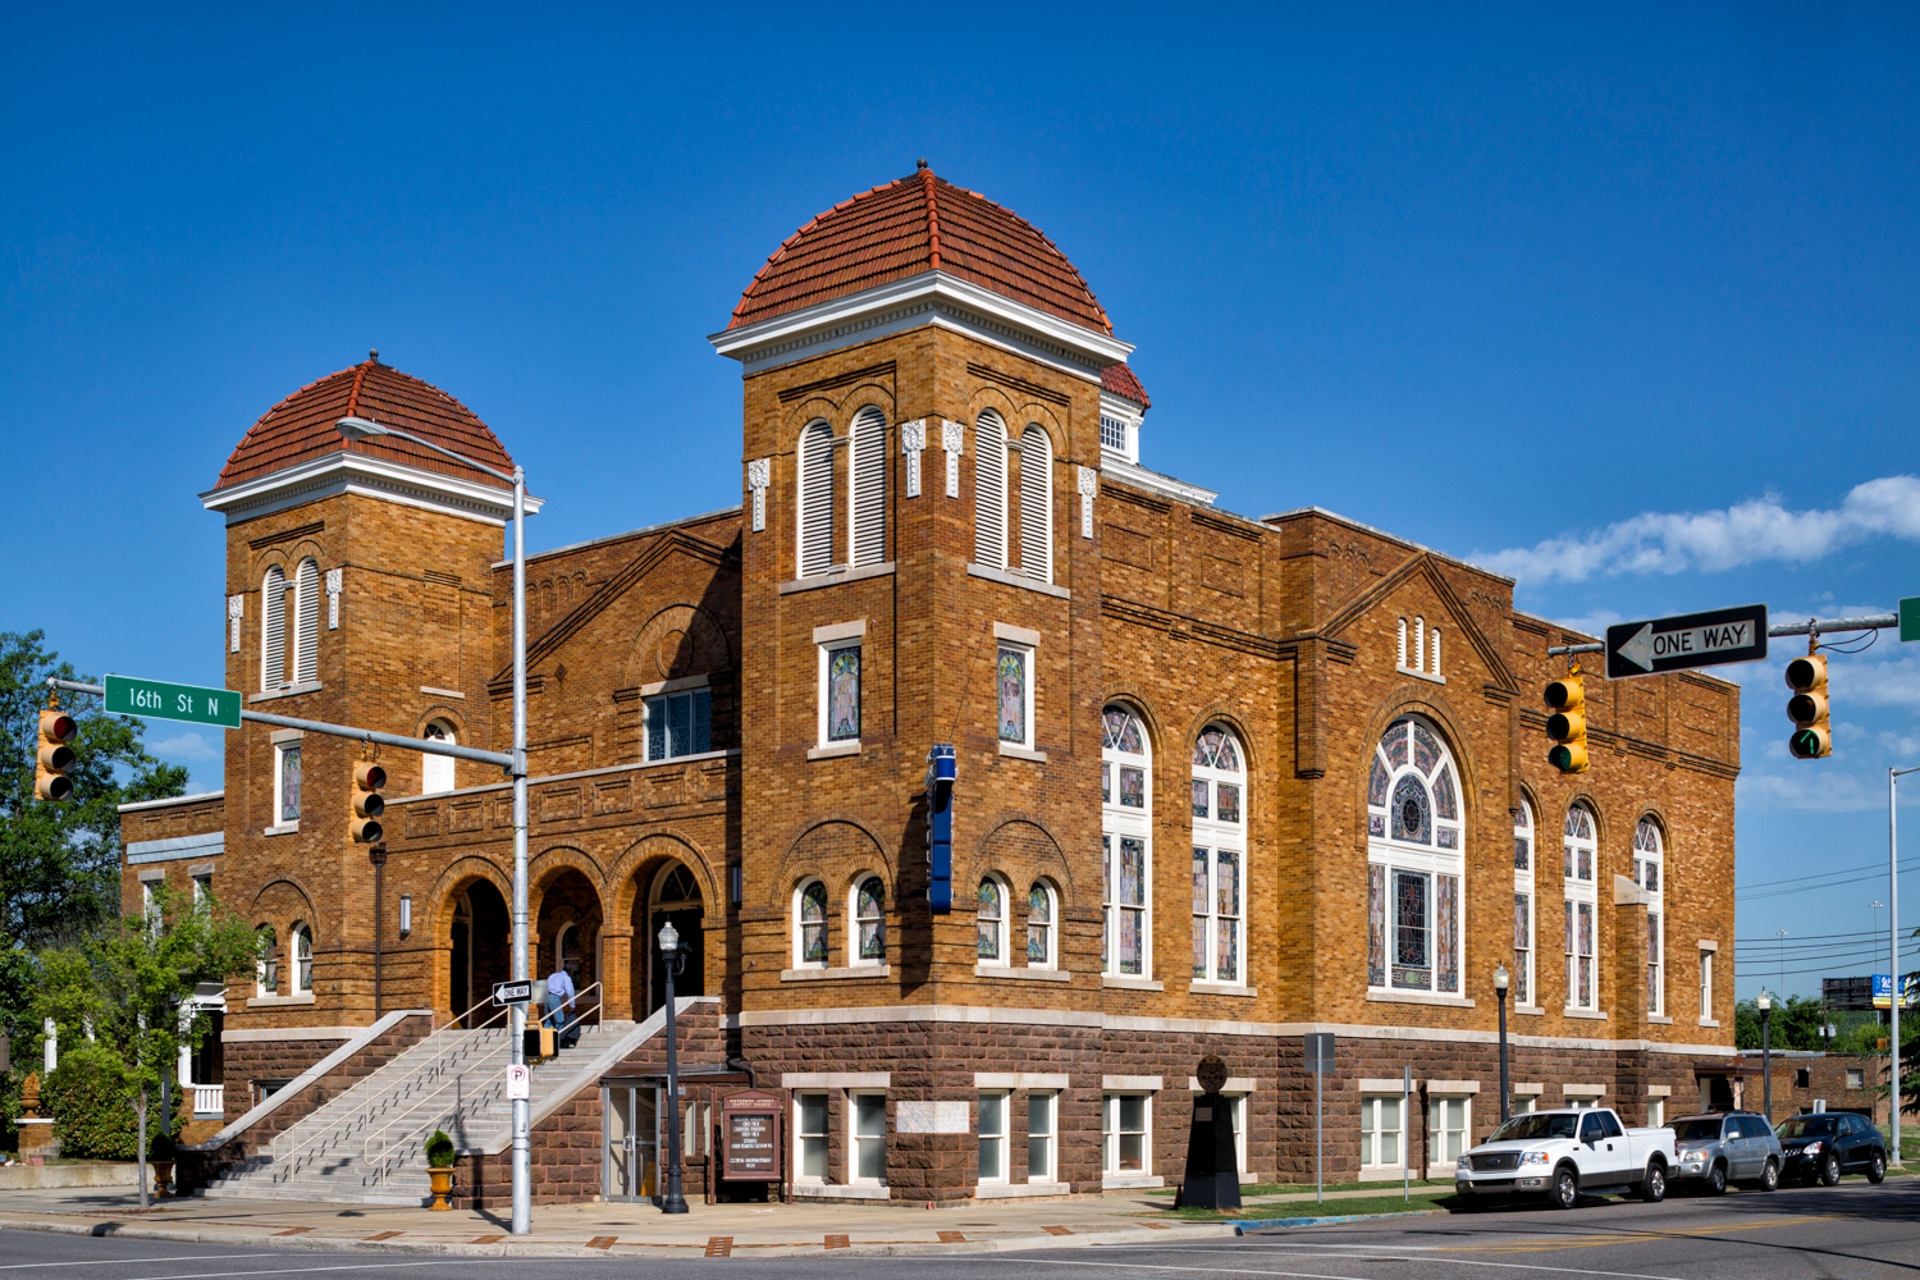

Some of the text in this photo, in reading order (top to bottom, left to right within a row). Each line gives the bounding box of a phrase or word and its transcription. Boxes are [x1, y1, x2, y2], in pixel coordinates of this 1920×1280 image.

[1653, 623, 1746, 655] ONE WAY
[129, 687, 218, 716] 16th St N
[504, 986, 528, 998] ONE WAY
